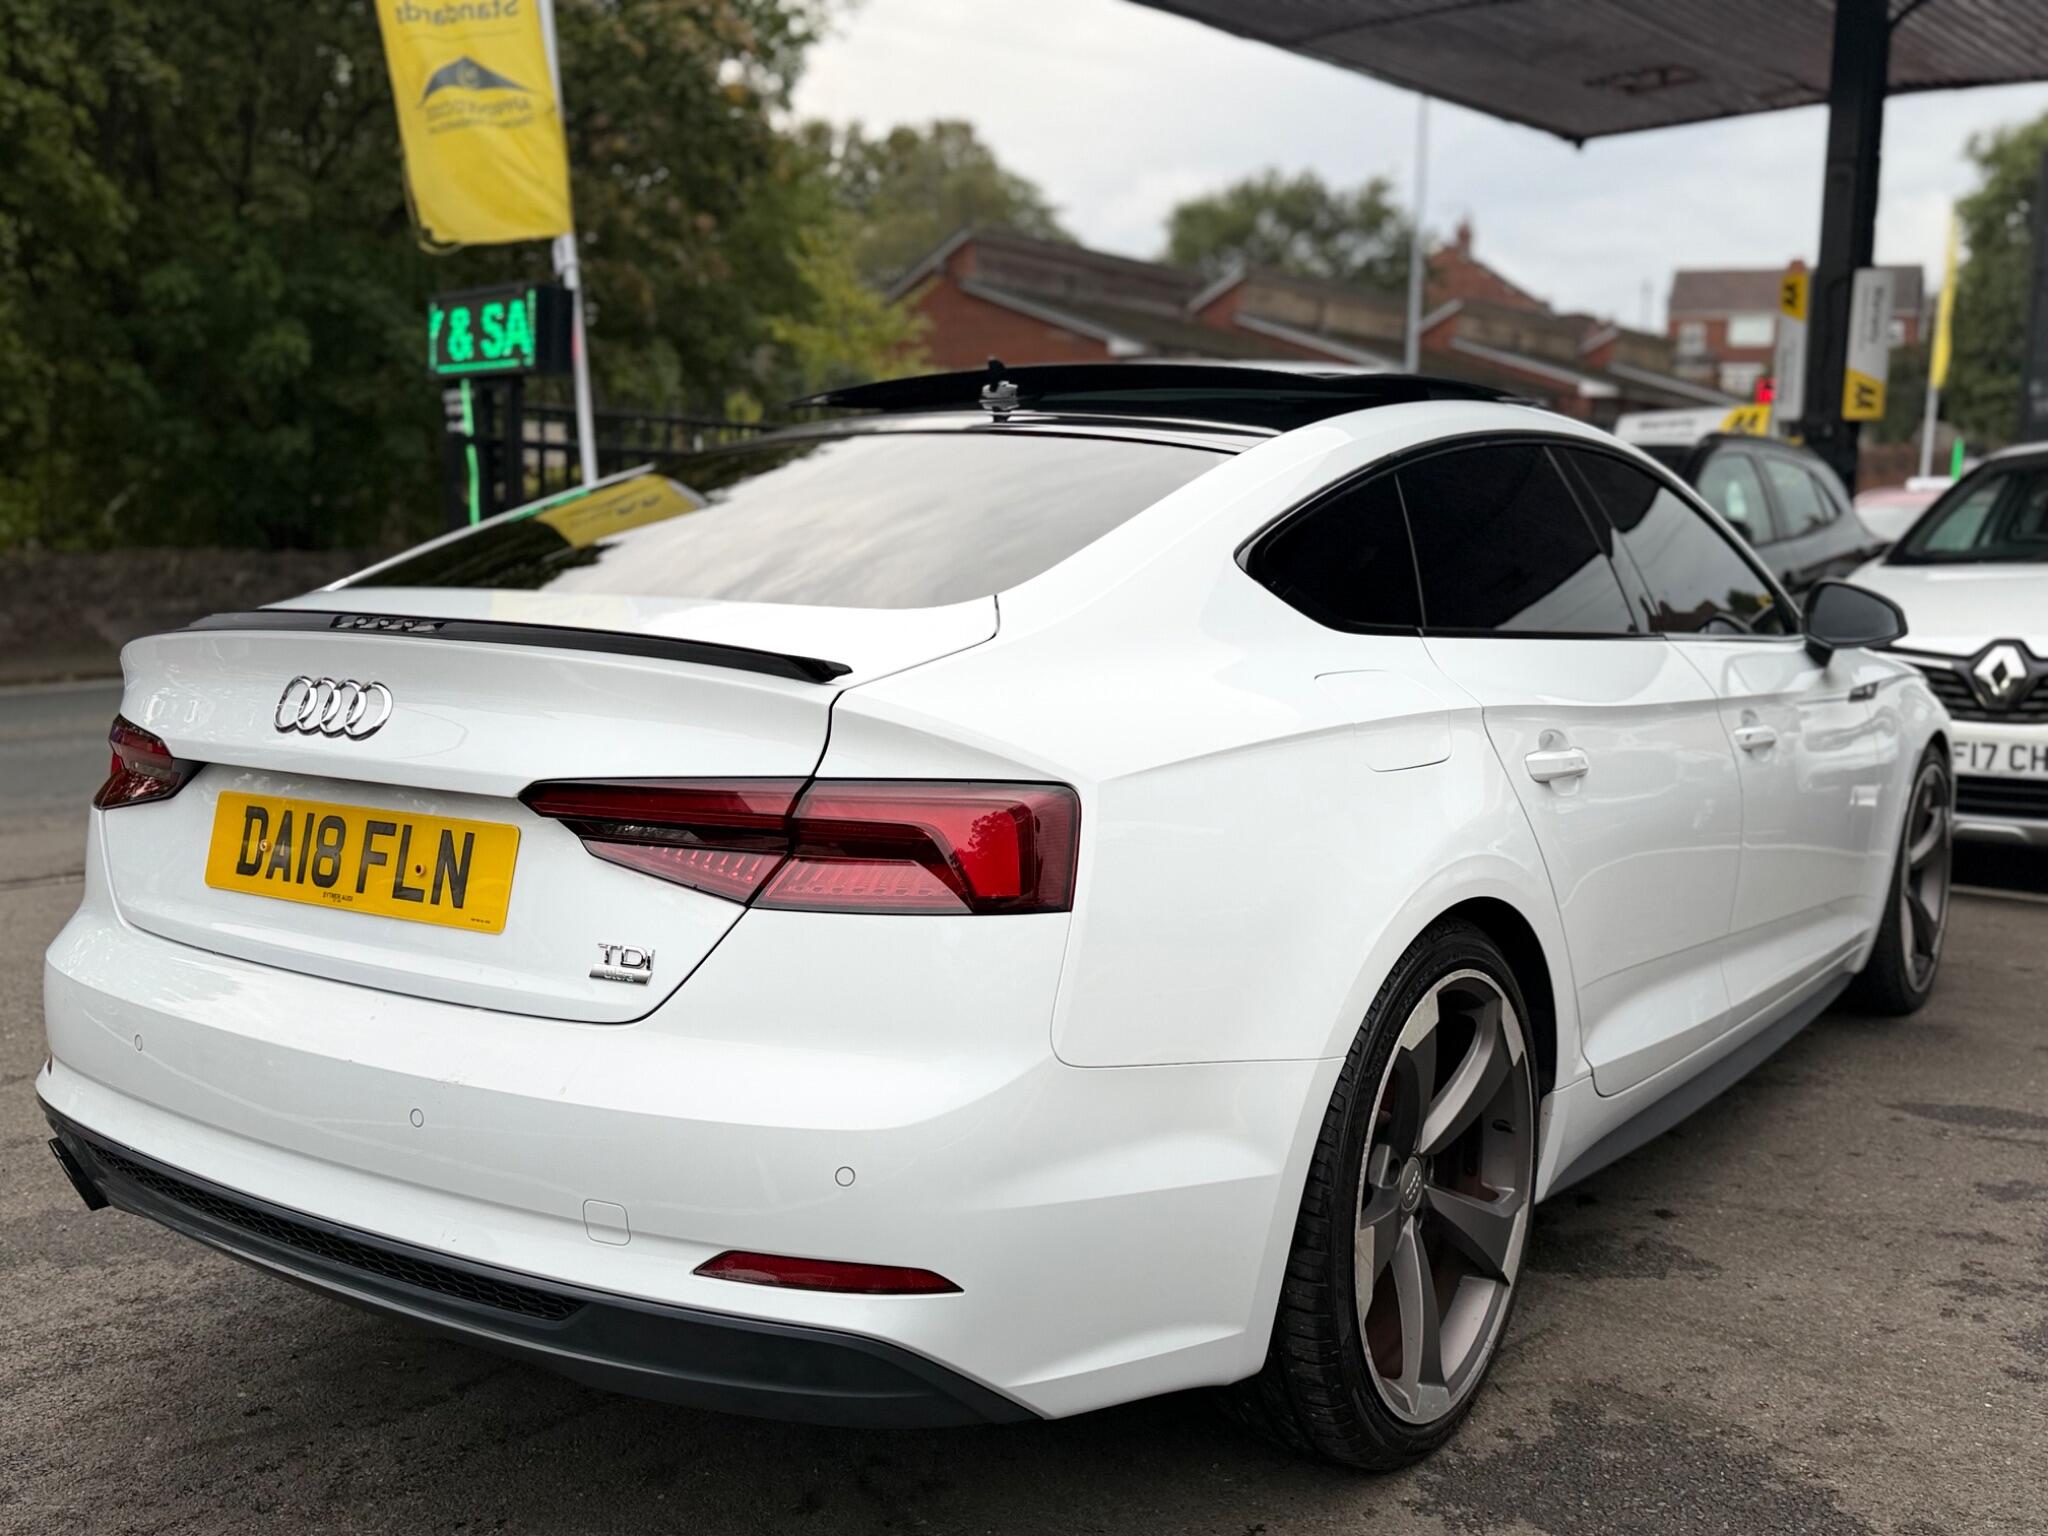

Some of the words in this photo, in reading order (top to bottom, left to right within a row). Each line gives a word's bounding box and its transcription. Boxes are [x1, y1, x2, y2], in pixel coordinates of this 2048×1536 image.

[449, 307, 474, 362] &
[481, 299, 531, 359] SA
[2009, 745, 2048, 771] CH
[235, 805, 346, 888] DA18
[355, 820, 475, 909] FLN
[598, 943, 655, 971] TDI
